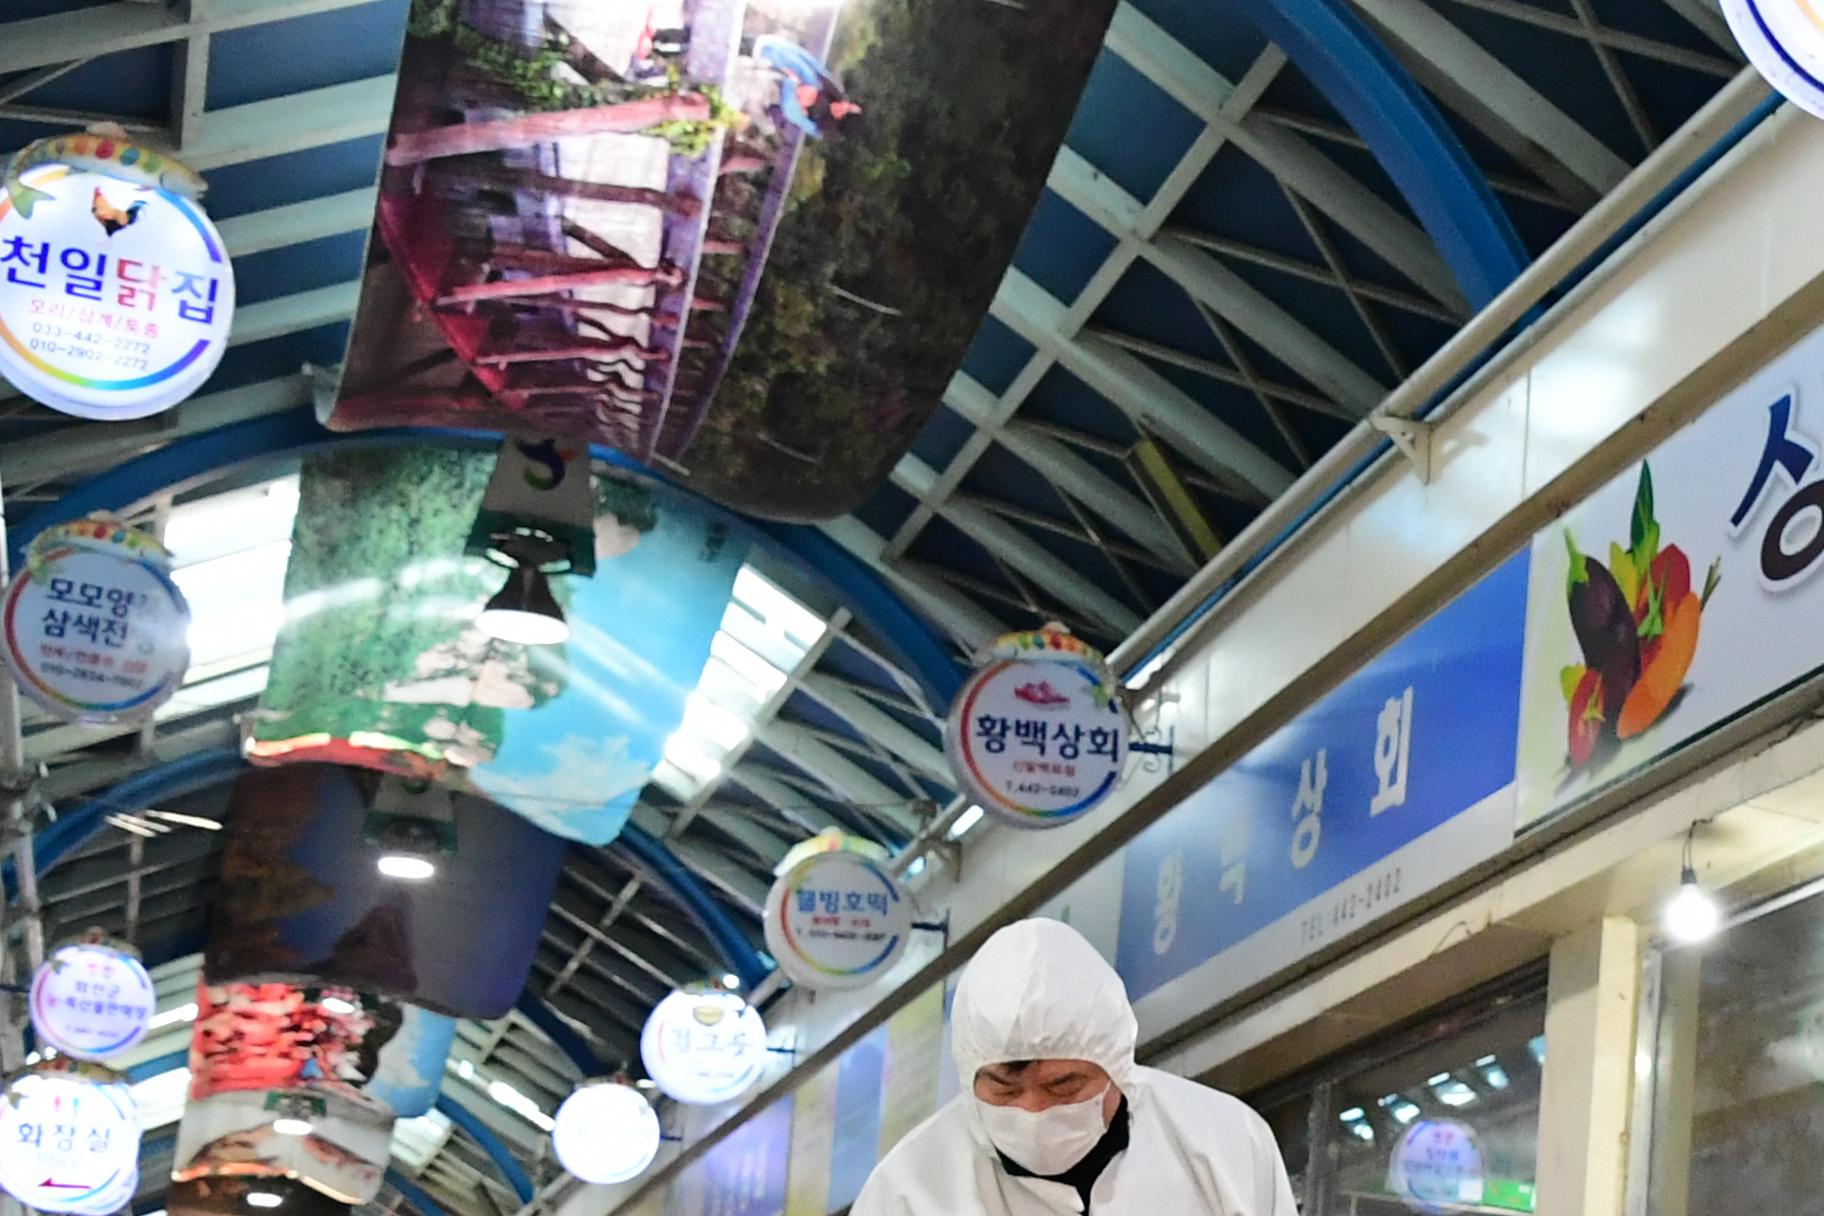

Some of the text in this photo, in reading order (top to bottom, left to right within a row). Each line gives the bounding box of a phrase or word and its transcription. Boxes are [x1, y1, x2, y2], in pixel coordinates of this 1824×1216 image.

[0, 236, 218, 325] 천일닭집
[43, 609, 128, 648] 삼색전
[976, 714, 1119, 762] 황백상회
[17, 1120, 111, 1154] 화장실
